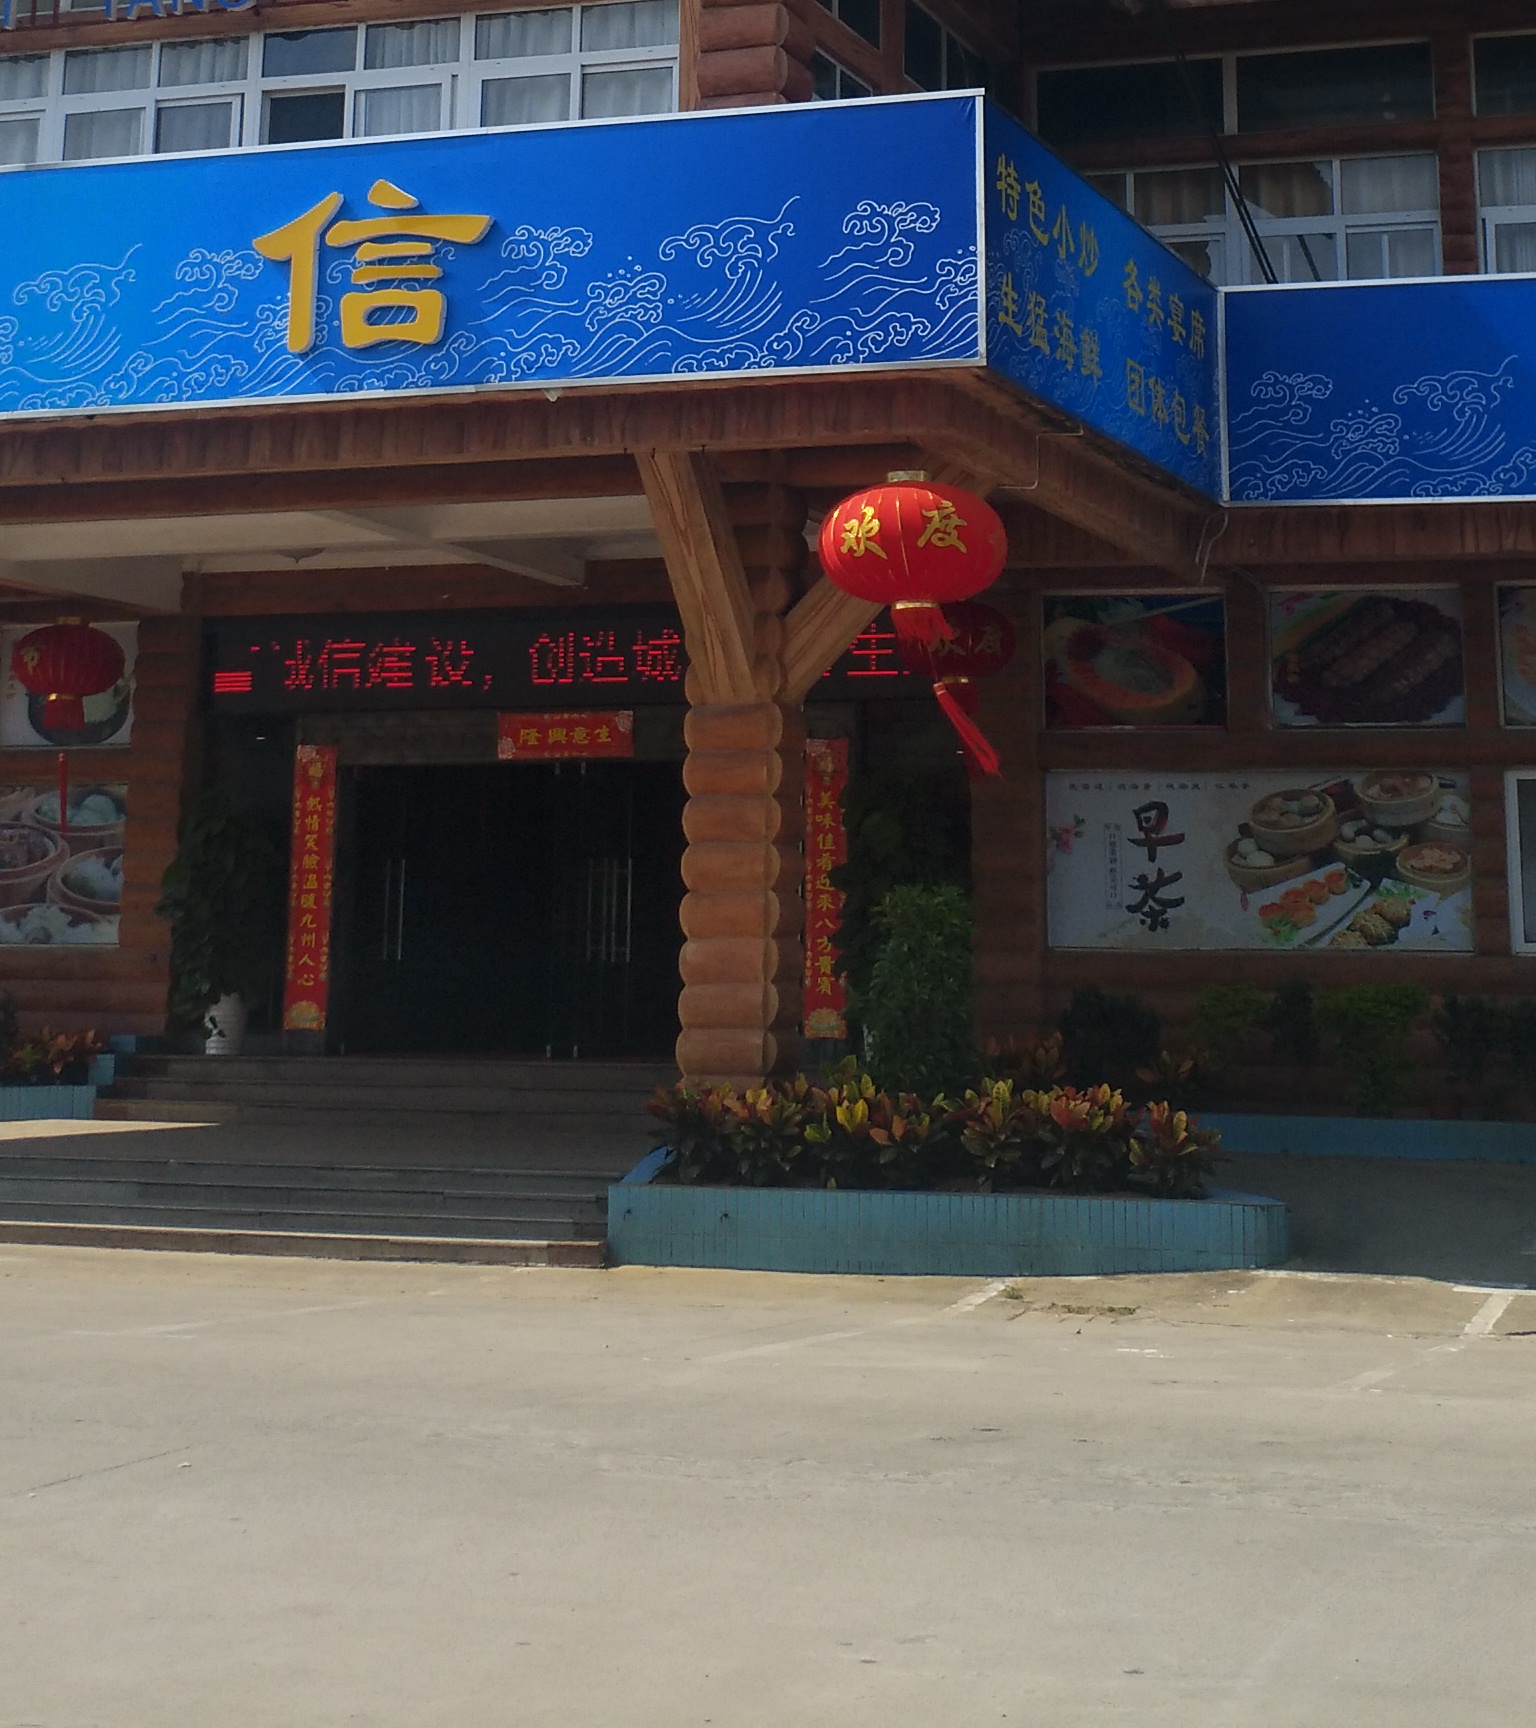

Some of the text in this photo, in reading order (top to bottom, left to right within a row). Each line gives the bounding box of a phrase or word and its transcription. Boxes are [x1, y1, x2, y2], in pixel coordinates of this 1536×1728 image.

[996, 153, 1100, 277] 特色小炒
[998, 271, 1210, 456] 生猛海鲜 团体包餐
[839, 500, 968, 562] 欢度
[1125, 800, 1186, 932] 早茶
